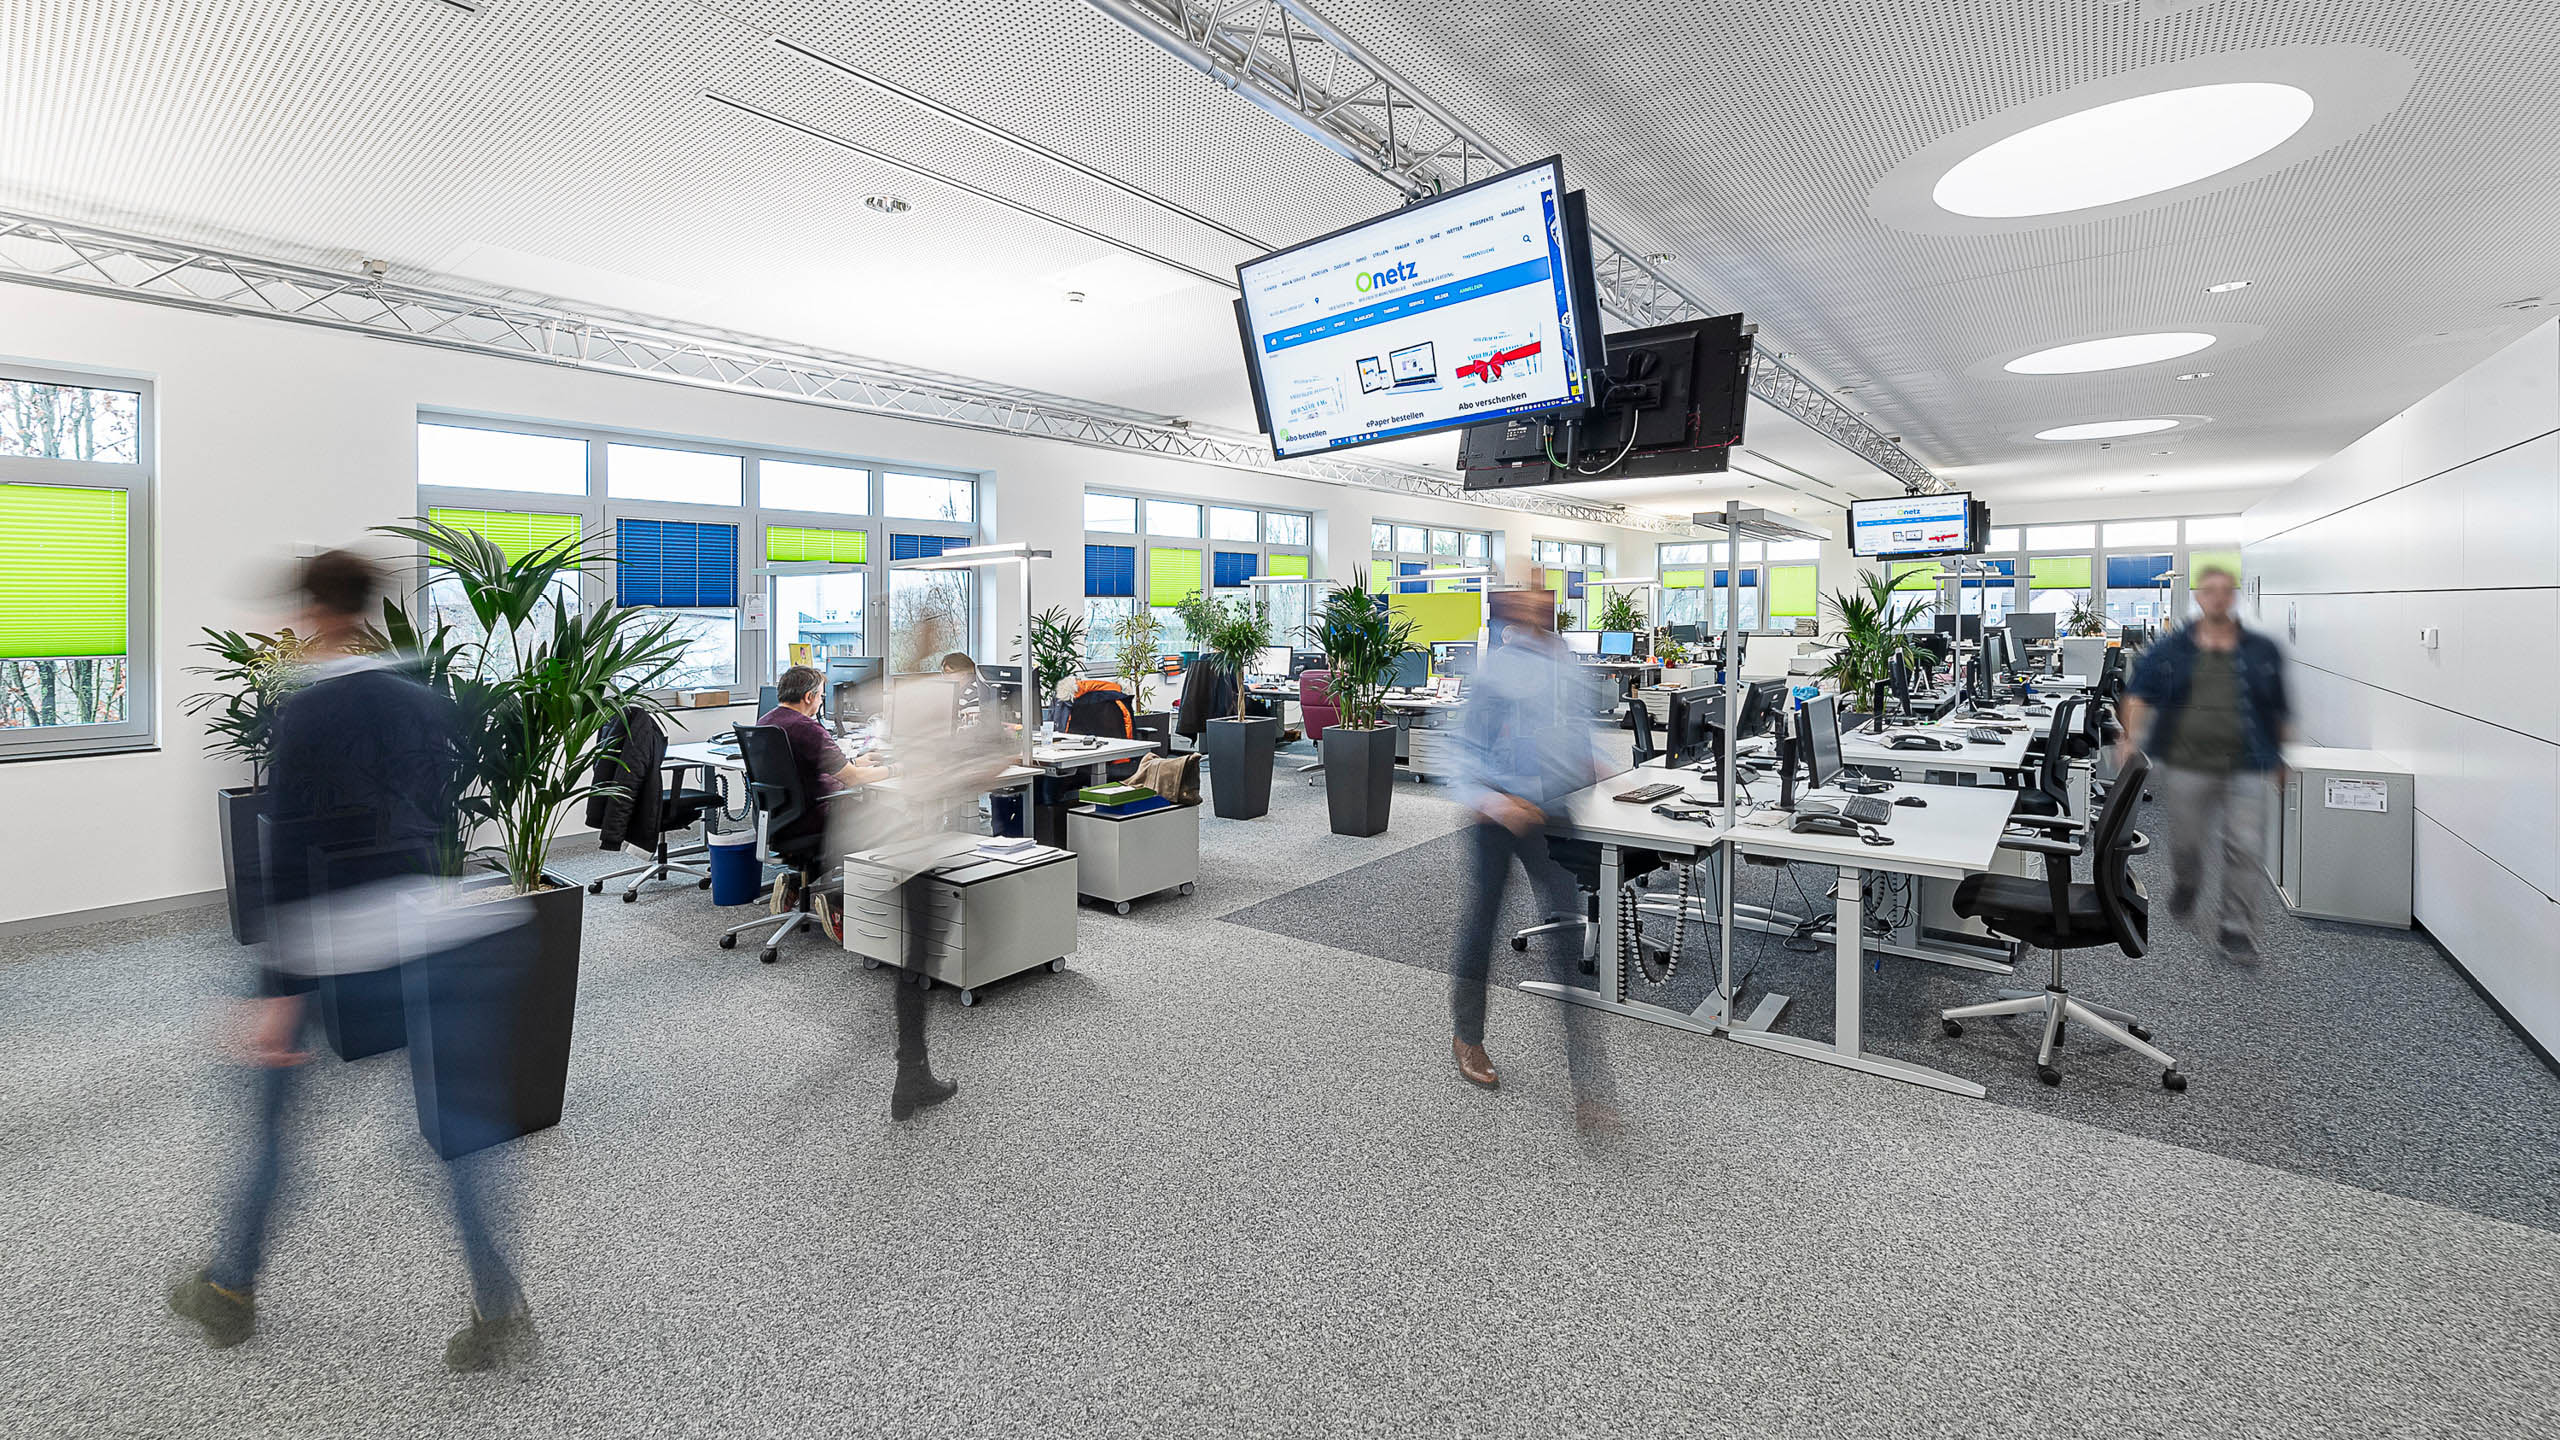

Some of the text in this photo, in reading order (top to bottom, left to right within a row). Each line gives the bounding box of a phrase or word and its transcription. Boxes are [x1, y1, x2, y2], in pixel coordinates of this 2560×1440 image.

[1500, 205, 1525, 218] MAGAZINE
[1469, 215, 1494, 227] PROSPEKTE
[1446, 225, 1463, 235] WETTER
[1356, 260, 1418, 292] Onetz
[1458, 390, 1527, 411] Abo verschenken
[1365, 409, 1424, 429] ePaper bestellen
[1298, 428, 1327, 440] bestellen
